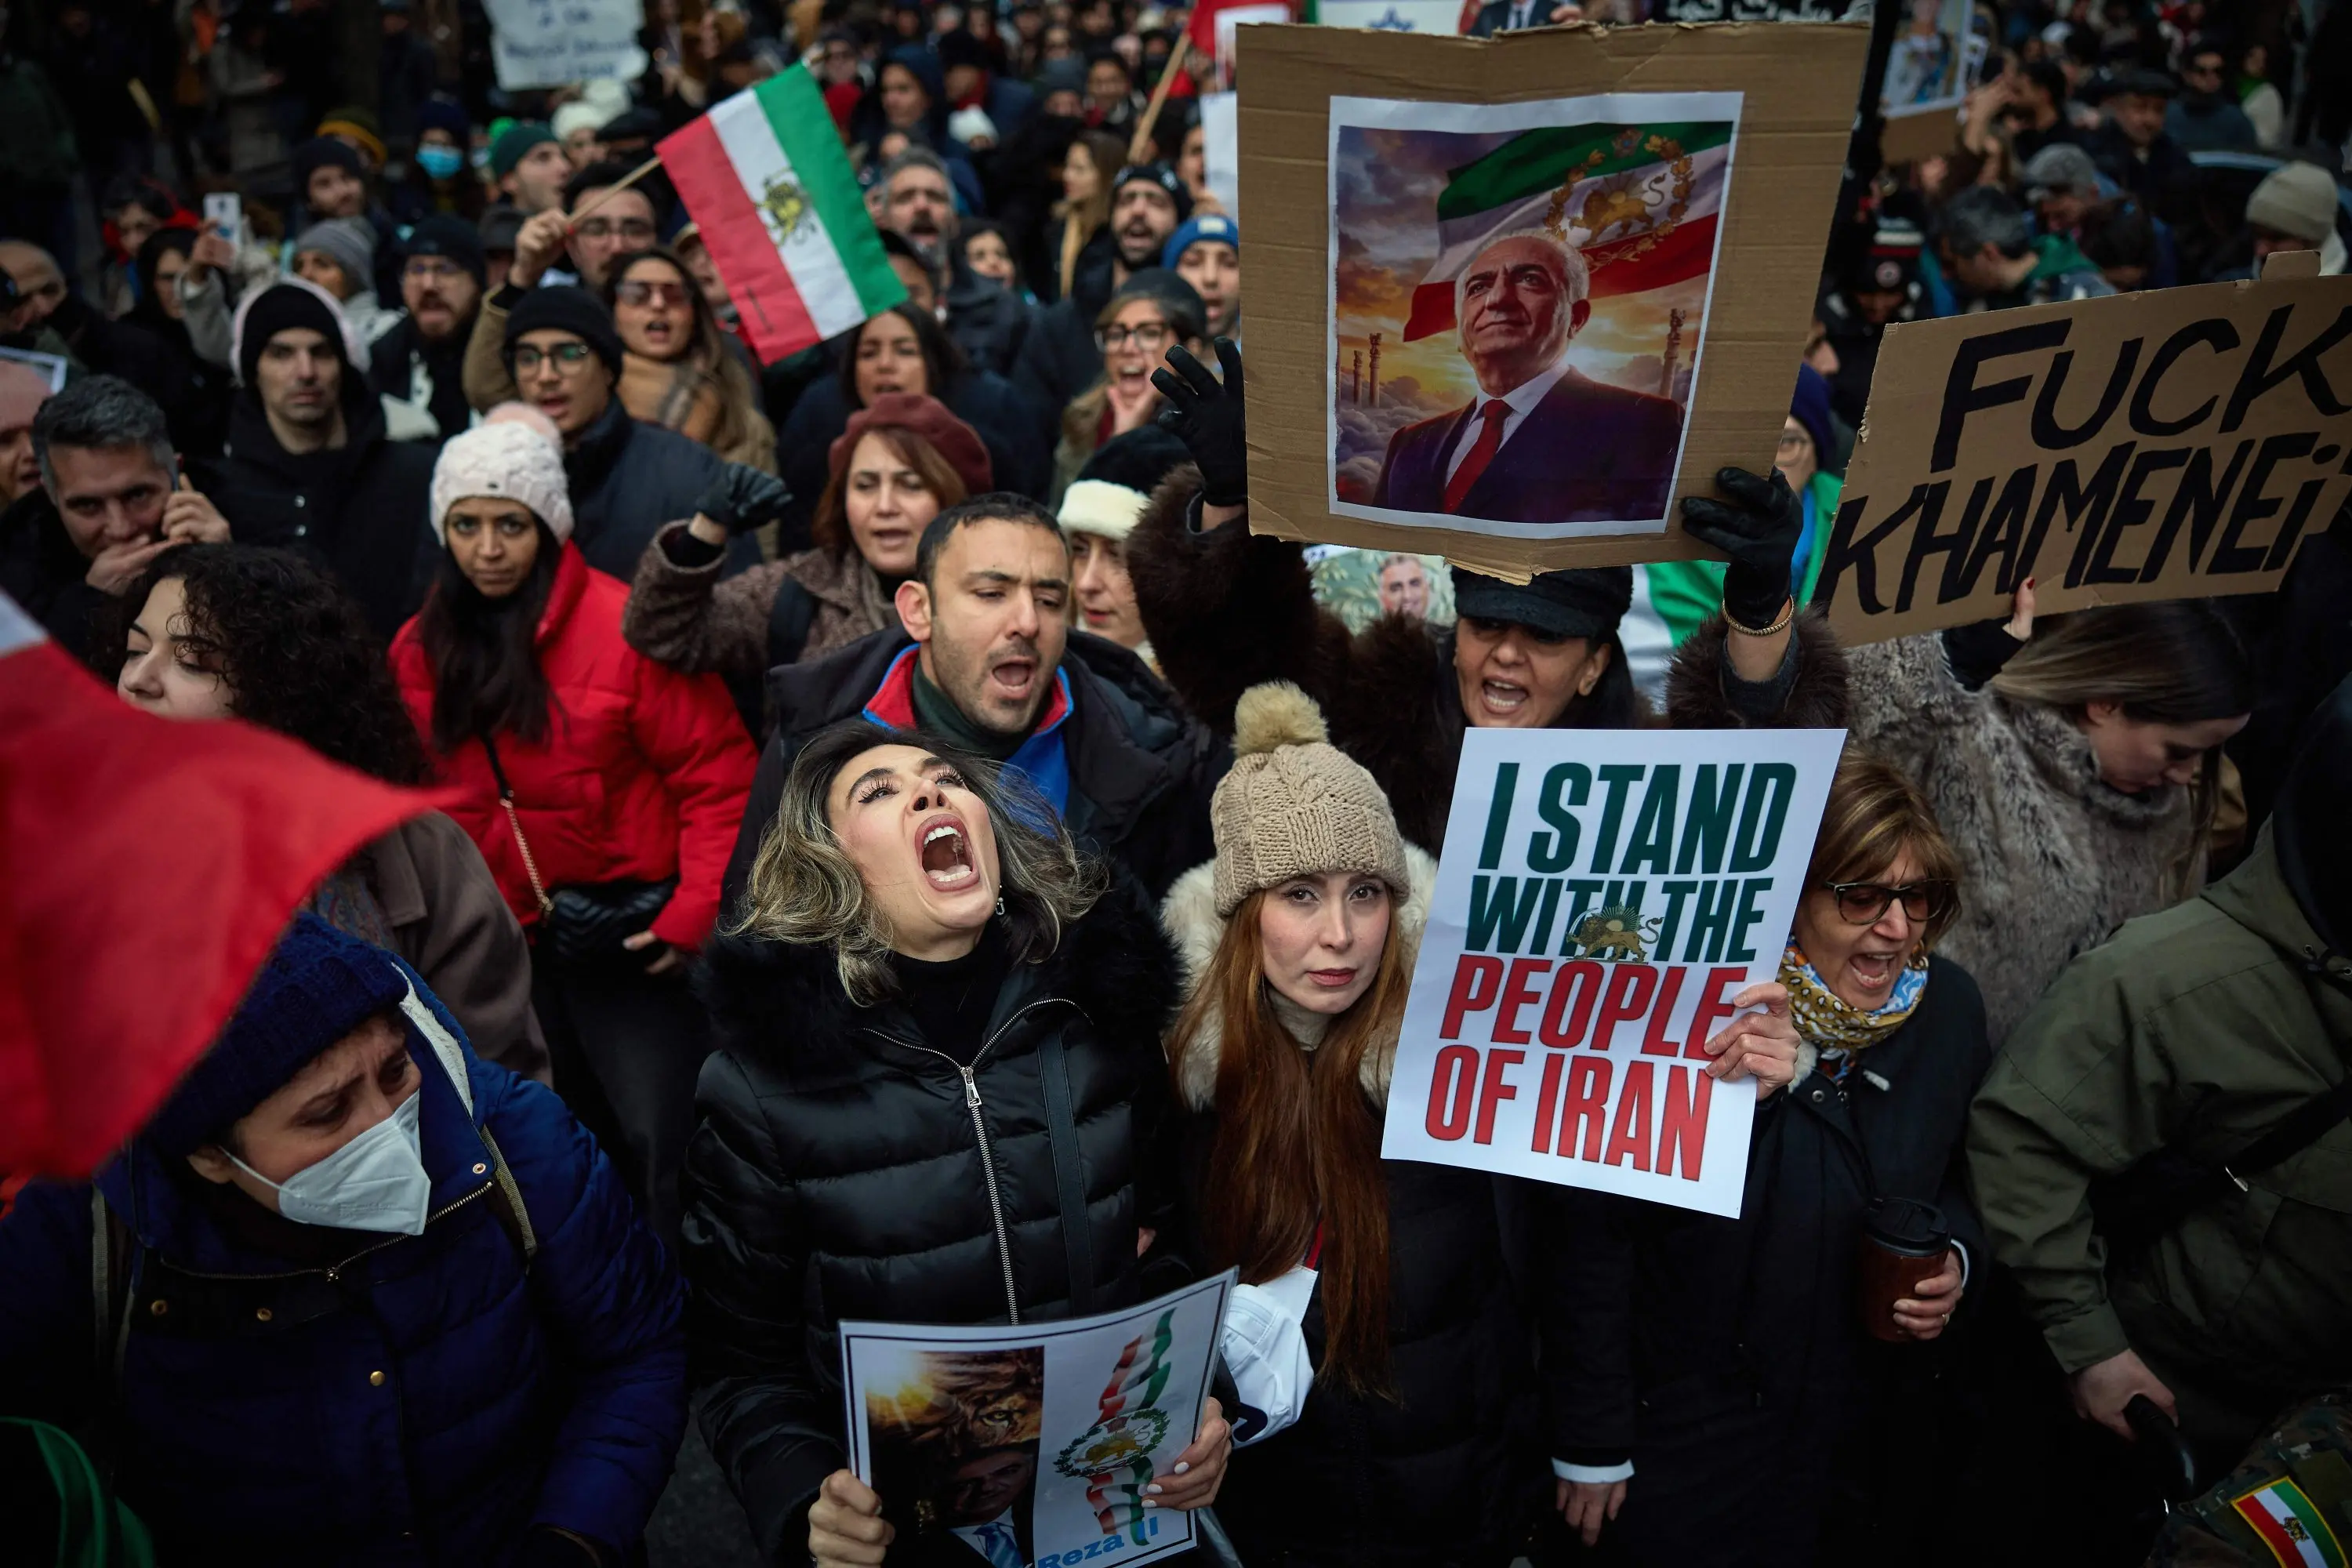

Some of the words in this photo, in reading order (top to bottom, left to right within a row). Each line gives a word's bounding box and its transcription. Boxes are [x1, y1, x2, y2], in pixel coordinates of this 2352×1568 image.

[1930, 303, 2352, 473] FUCK
[1478, 762, 1520, 870] I
[1526, 761, 1797, 875] STAND
[1465, 875, 1646, 960] WITH
[1653, 877, 1774, 964] THE
[1439, 954, 1748, 1062] PEOPLE
[1425, 1044, 1526, 1145] OF
[1530, 1053, 1715, 1182] IRAN
[1037, 1534, 1124, 1568] Reza
